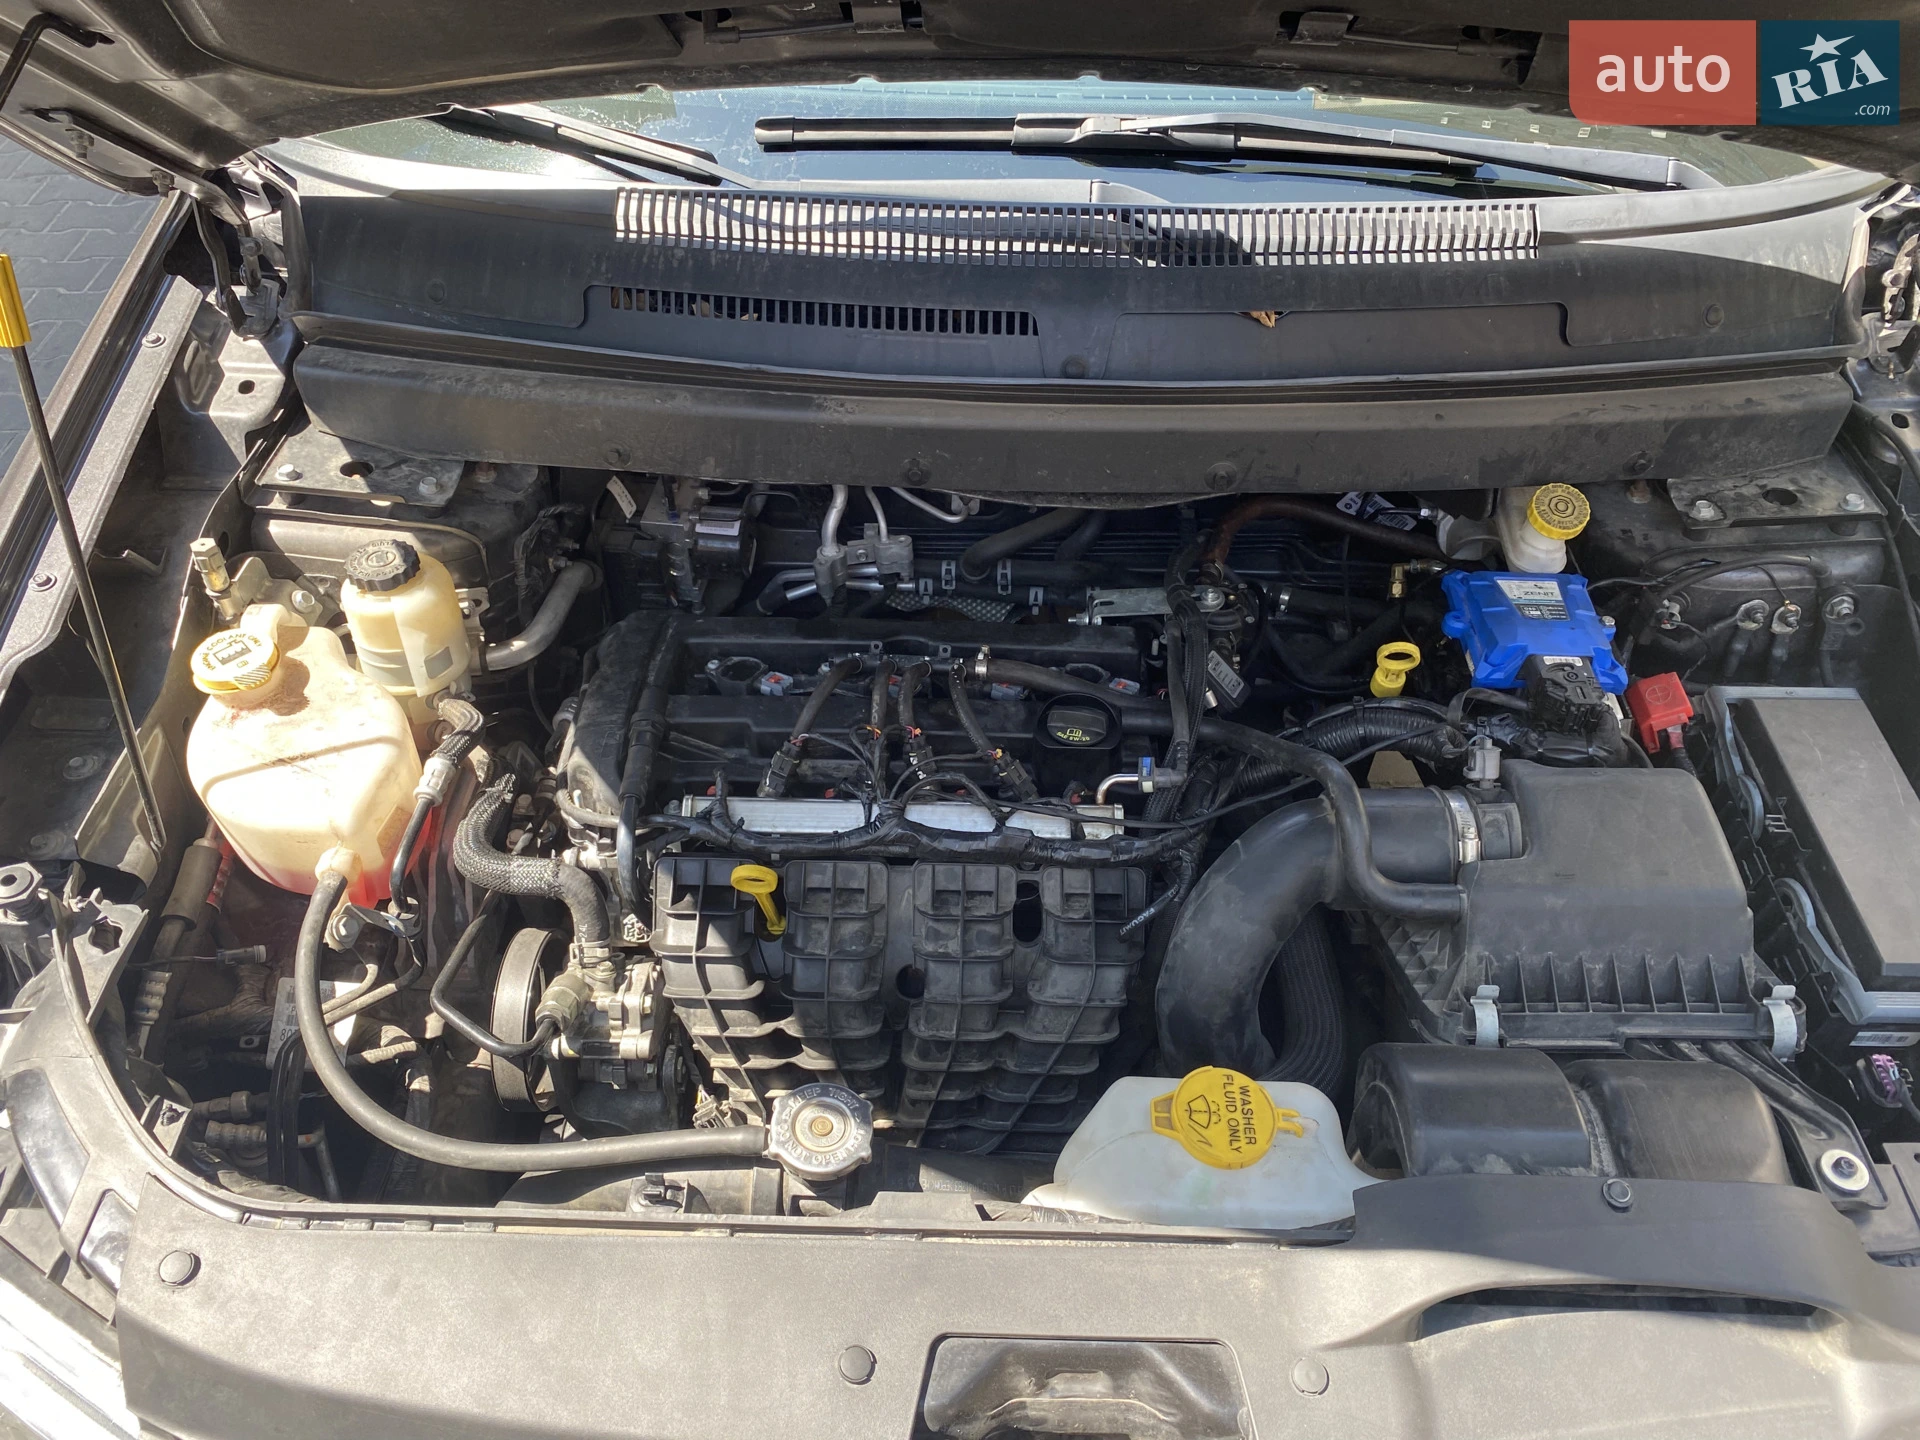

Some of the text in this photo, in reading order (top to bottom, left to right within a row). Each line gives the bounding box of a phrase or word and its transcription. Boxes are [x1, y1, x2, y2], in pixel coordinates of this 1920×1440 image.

[206, 633, 247, 651] COOLANT
[788, 1087, 860, 1109] KEEP TIGHT
[1222, 1074, 1243, 1154] FLUID ONLY
[1239, 1085, 1257, 1145] WASHER
[784, 1141, 809, 1161] NOT
[812, 1147, 847, 1164] OPEN
